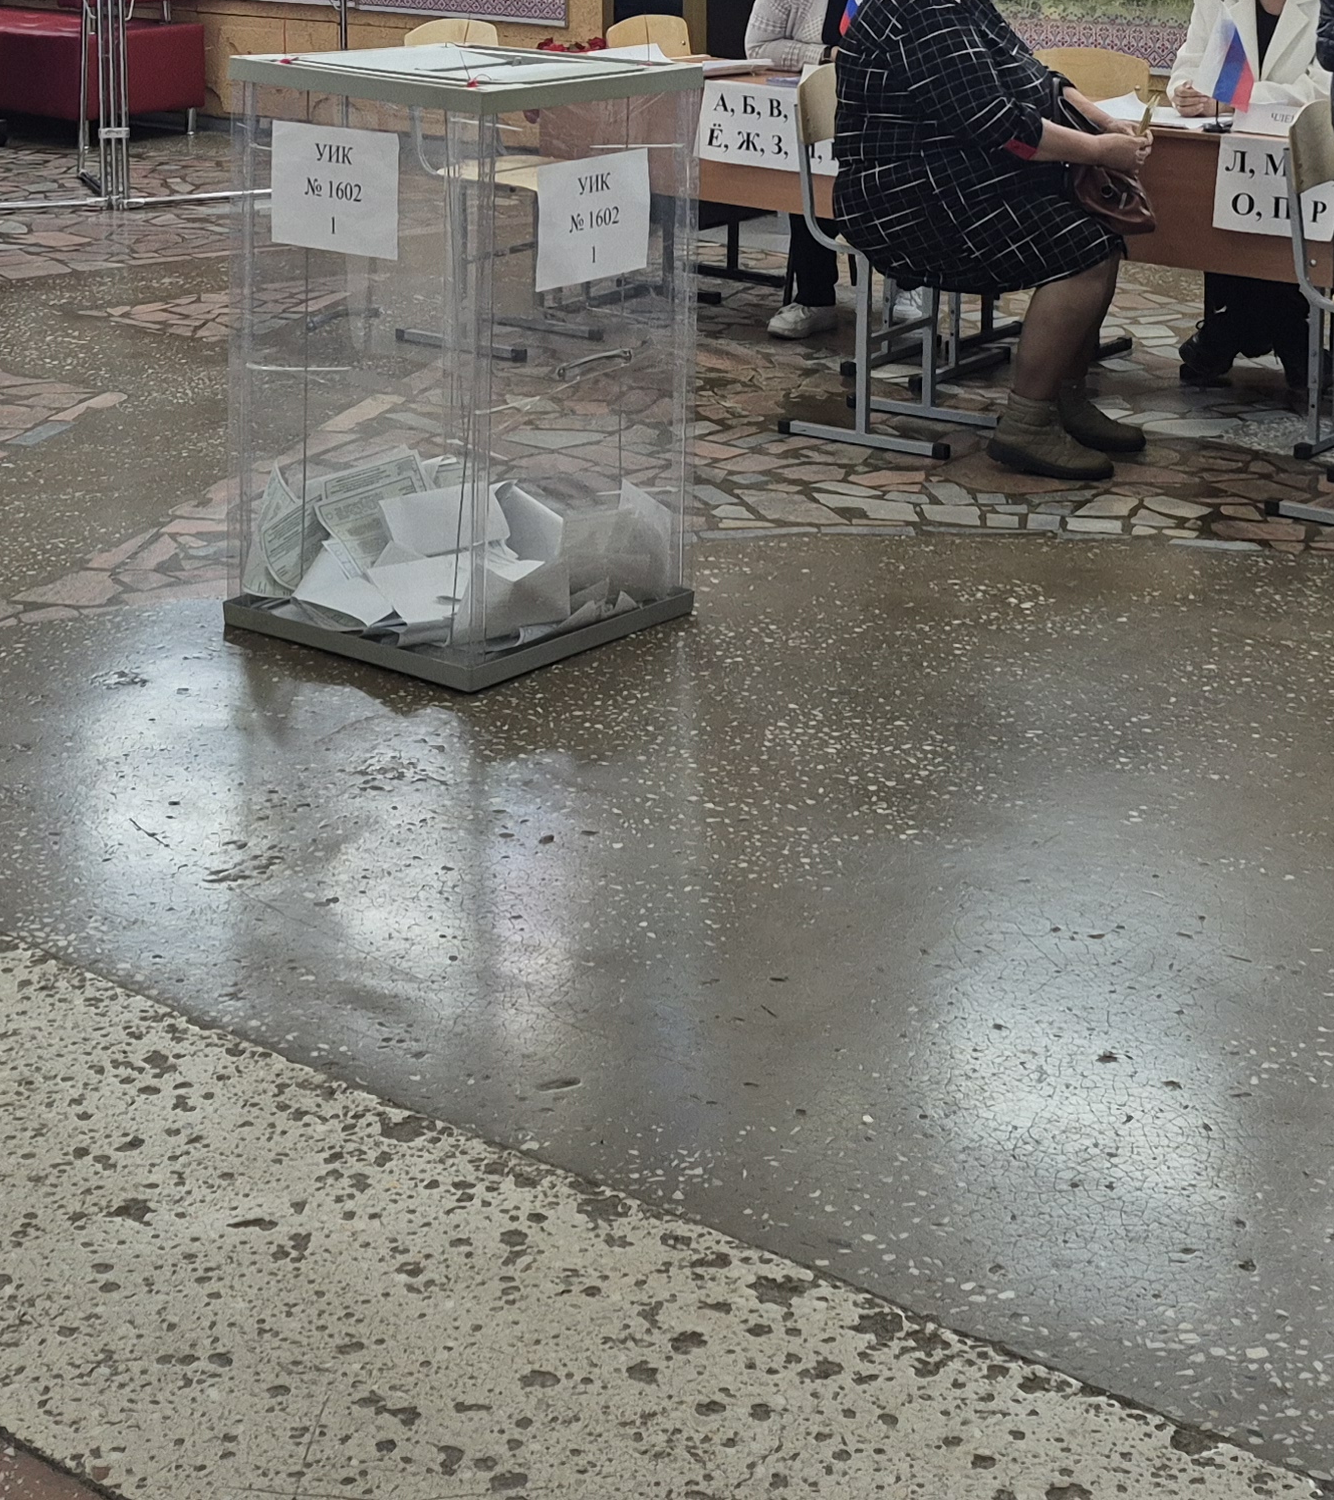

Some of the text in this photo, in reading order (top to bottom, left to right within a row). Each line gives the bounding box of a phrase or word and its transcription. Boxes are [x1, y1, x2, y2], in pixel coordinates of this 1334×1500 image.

[713, 93, 788, 123] А, Б, В,
[314, 143, 353, 166] УИК
[707, 123, 729, 152] Ё,
[737, 131, 764, 157] Ж,
[771, 135, 789, 160] З,
[1225, 150, 1255, 178] Л,
[305, 178, 363, 203] № 1602
[577, 172, 611, 196] УИК
[569, 206, 620, 234] № 1602
[1231, 193, 1262, 221] О,
[1310, 200, 1328, 224] Р
[330, 216, 336, 235] 1
[591, 246, 597, 264] 1
